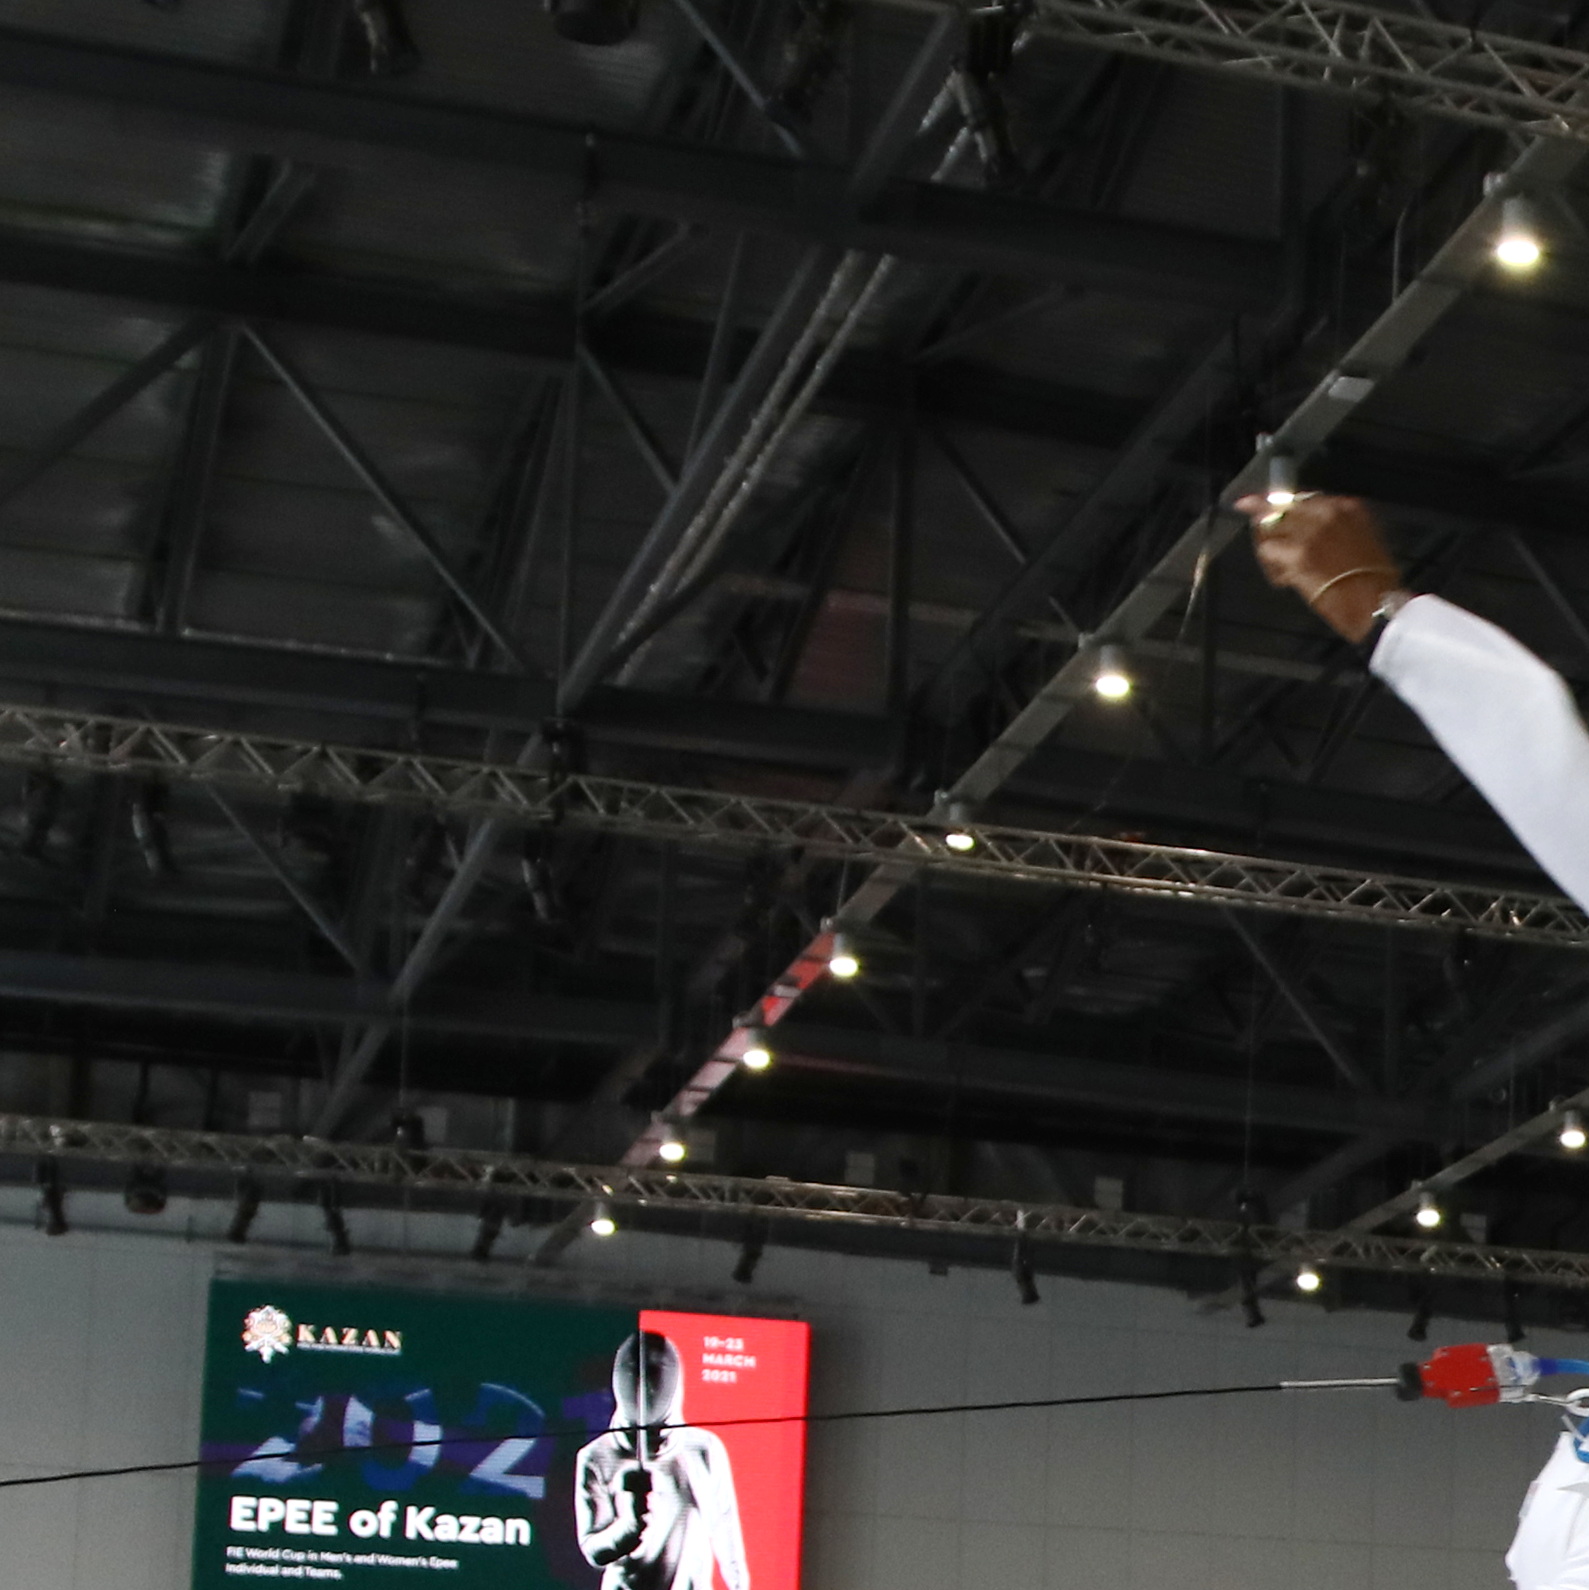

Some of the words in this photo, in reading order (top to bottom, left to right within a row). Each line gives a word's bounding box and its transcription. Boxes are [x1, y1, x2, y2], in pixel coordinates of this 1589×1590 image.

[297, 1322, 402, 1349] KAZAN
[702, 1353, 756, 1369] MARCH
[702, 1369, 737, 1384] 2021
[229, 1495, 339, 1536] EPEE
[349, 1500, 399, 1539] of
[405, 1505, 531, 1546] Kazan
[245, 1547, 279, 1560] World
[281, 1548, 305, 1562] Cup
[307, 1550, 318, 1561] in
[320, 1551, 352, 1564] Men's
[353, 1552, 376, 1565] and
[378, 1554, 427, 1567] Women's
[429, 1556, 459, 1570] Epee
[225, 1562, 279, 1576] Individual
[280, 1565, 304, 1577] and
[305, 1566, 343, 1580] Teams.
